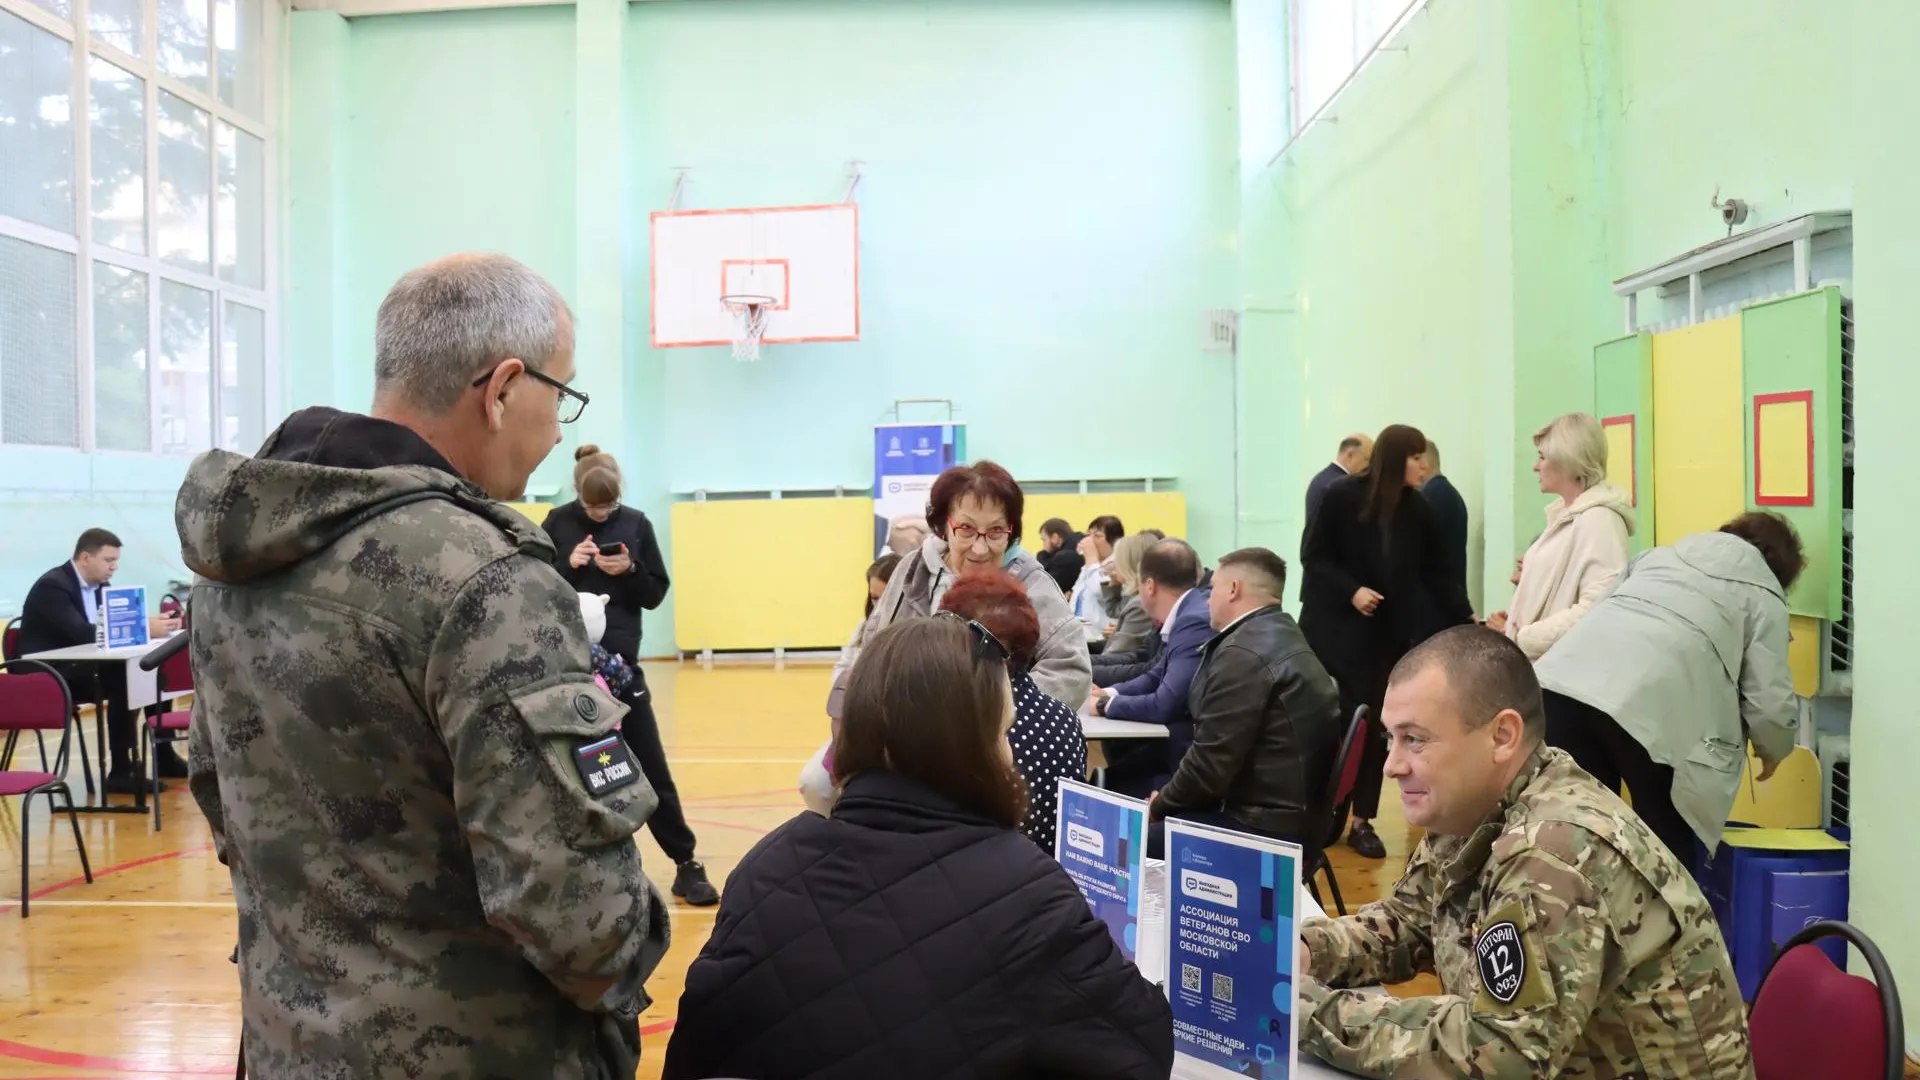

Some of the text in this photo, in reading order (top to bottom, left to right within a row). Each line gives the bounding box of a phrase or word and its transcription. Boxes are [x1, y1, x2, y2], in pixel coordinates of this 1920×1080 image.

[588, 760, 633, 789] ВКС РОССИИ
[1180, 904, 1239, 928] АССОЦИАЦИЯ
[1180, 916, 1251, 943] ВЕТЕРАНОВ СВО
[1179, 941, 1219, 959] ОБЛАСТИ
[1180, 928, 1238, 952] МОСКОВСКОЙ
[1479, 928, 1513, 958] ШТОРМ
[1488, 945, 1514, 980] 12
[1172, 1019, 1223, 1043] СОВМЕСТНЫЕ
[1223, 1035, 1245, 1050] ИДЕИ
[1196, 1037, 1233, 1057] РЕШЕНИЯ
